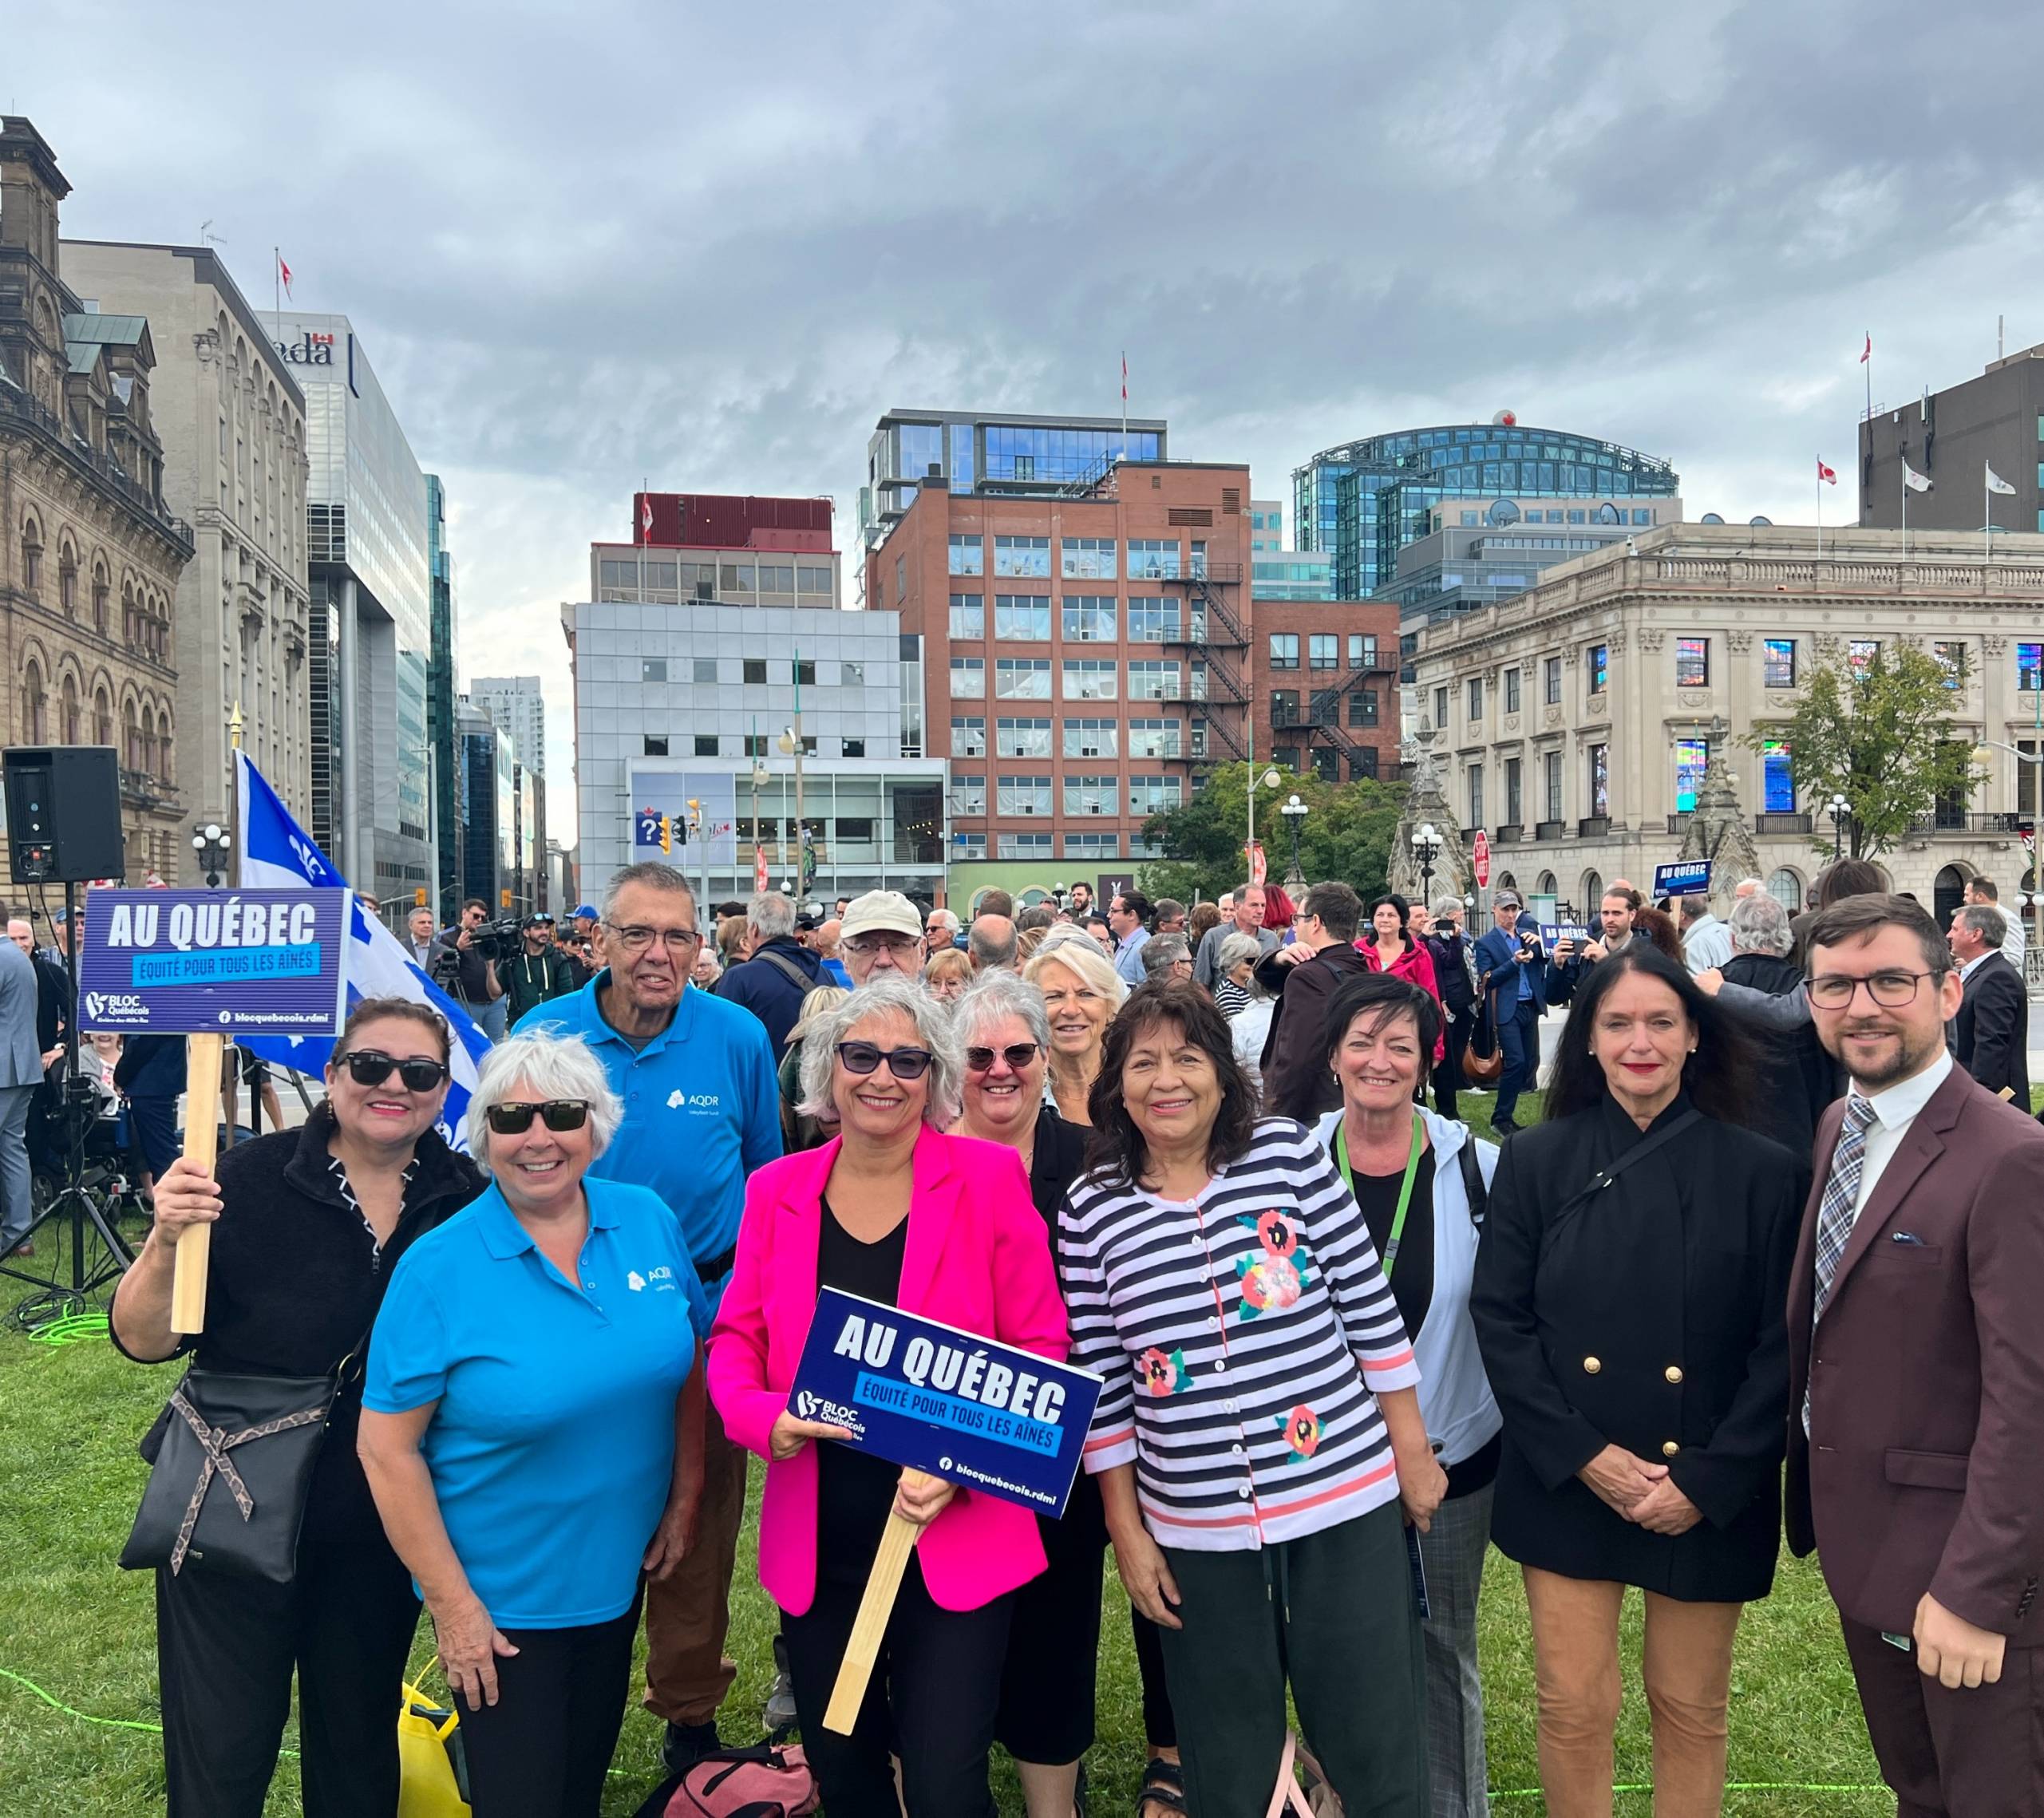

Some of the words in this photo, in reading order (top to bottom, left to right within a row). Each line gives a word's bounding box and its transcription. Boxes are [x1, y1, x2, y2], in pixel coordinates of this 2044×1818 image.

[1475, 840, 1487, 857] STOP
[1660, 867, 1673, 879] AU
[1674, 864, 1706, 879] QUÉBEC
[108, 904, 159, 947] AU
[168, 896, 315, 951] QUÉBEC
[1546, 927, 1557, 939] AU
[140, 958, 180, 980] ÉQUITÉ
[184, 958, 215, 976] POUR
[220, 956, 249, 974] TOUS
[253, 954, 274, 971] LES
[278, 949, 313, 969] AÎNÉS
[109, 995, 140, 1006] BLOC
[108, 1006, 150, 1016] Québécois
[235, 1013, 329, 1025] blocquebecois.rdmi
[688, 1094, 719, 1107] AQDR
[833, 1314, 899, 1369] AU
[901, 1337, 1066, 1425] QUÉBEC
[822, 1401, 859, 1421] BLOC
[862, 1378, 910, 1408] ÉQUITÉ
[911, 1393, 946, 1418] POUR
[951, 1405, 985, 1429] TOUS
[987, 1417, 1010, 1436] LES
[1014, 1420, 1054, 1448] AÎNÉS
[820, 1412, 866, 1433] Québécois
[955, 1463, 1058, 1506] blocquebecois.rdmi
